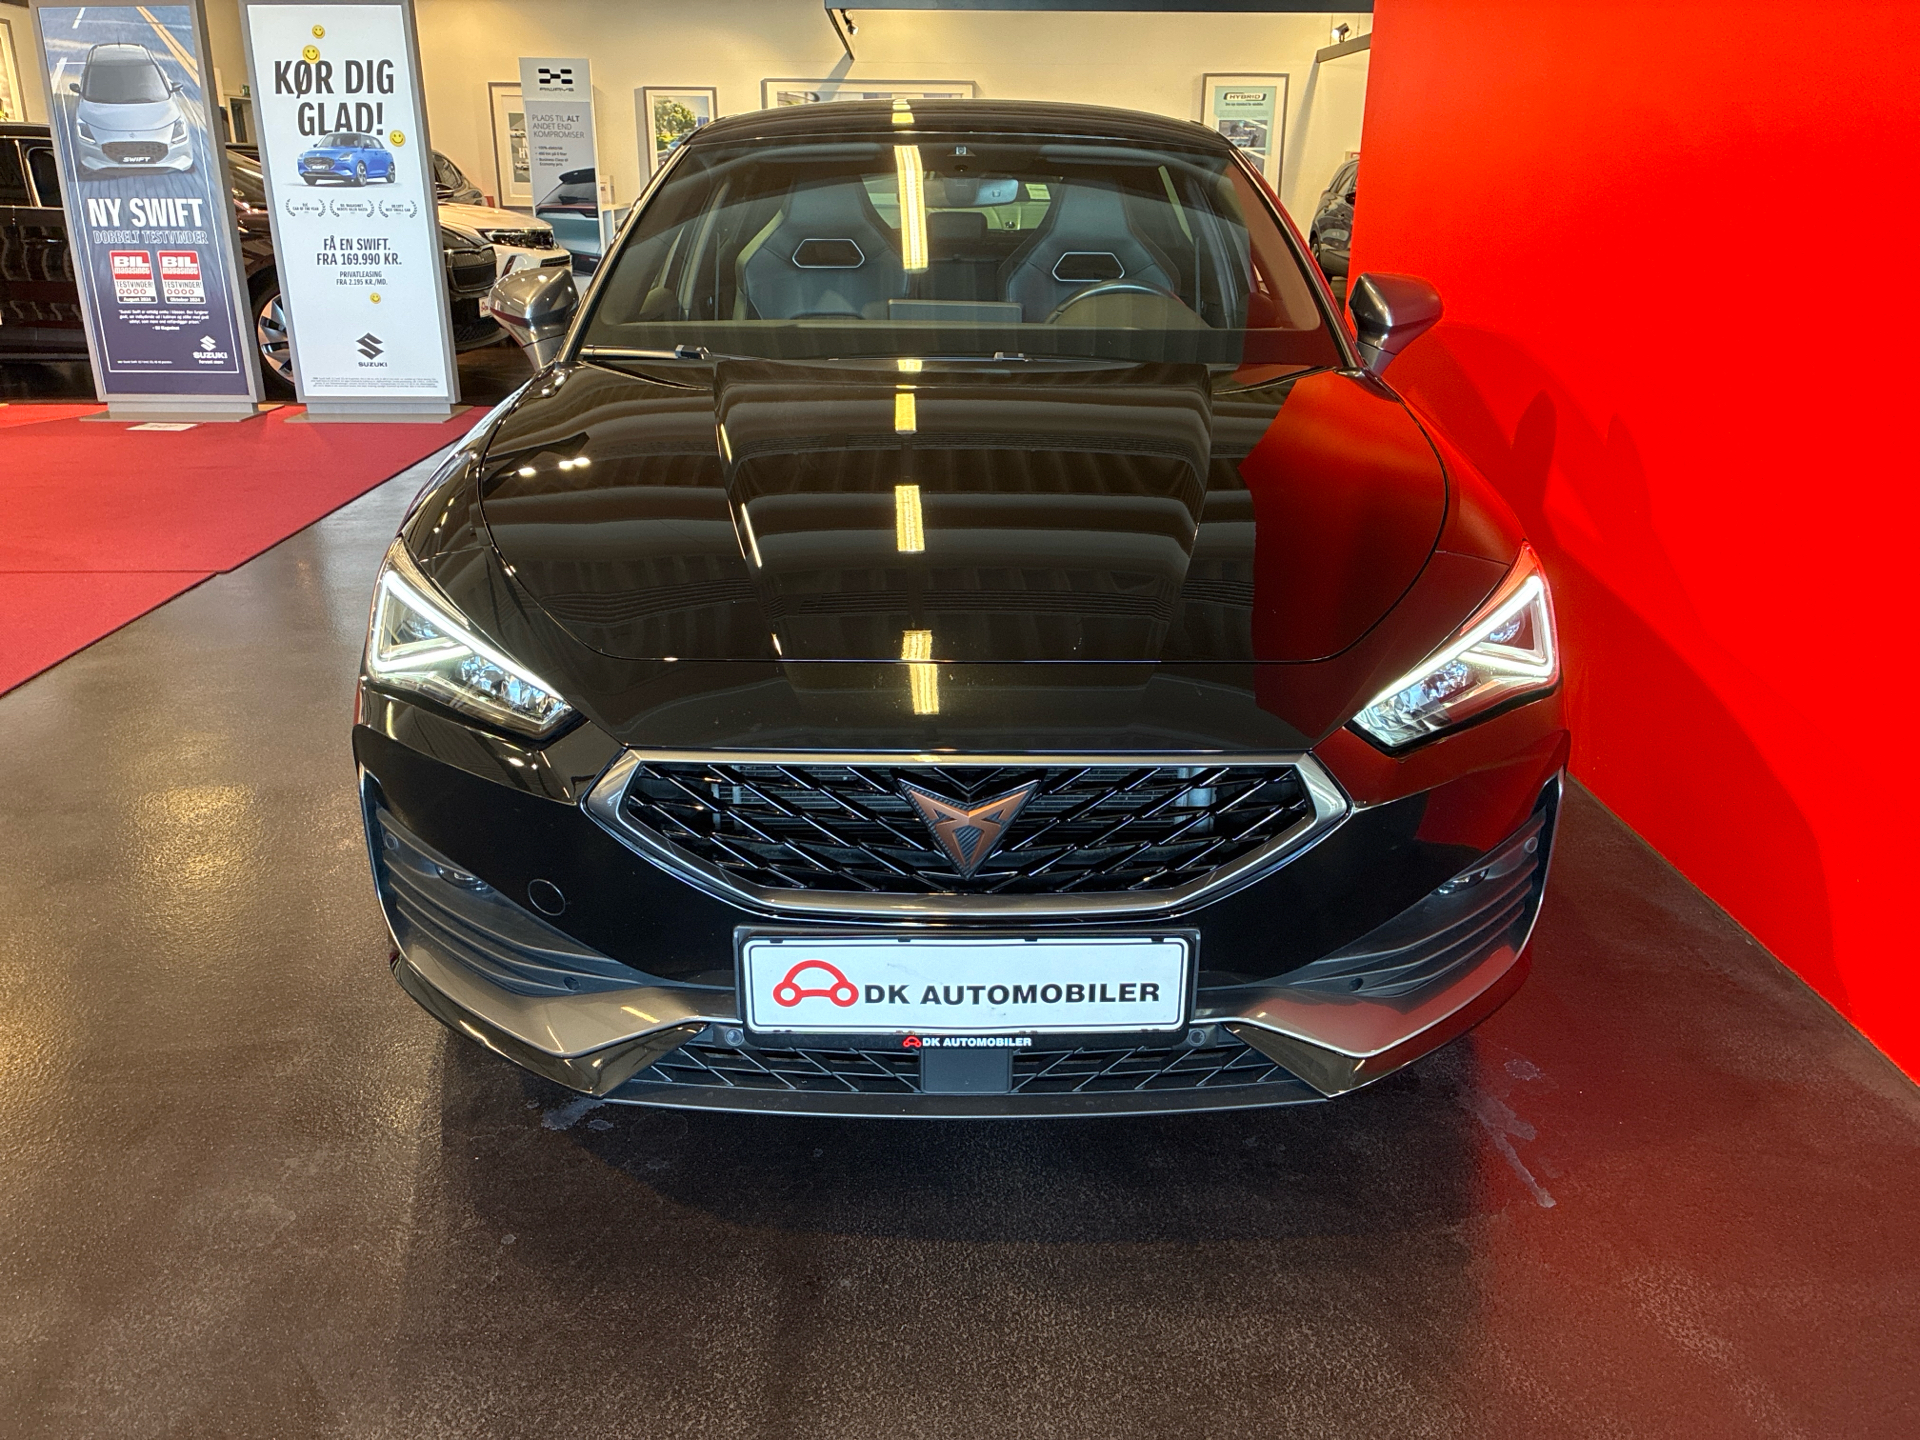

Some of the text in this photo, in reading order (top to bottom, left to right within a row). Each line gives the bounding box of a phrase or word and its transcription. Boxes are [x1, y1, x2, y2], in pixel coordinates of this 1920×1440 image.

[274, 59, 394, 98] KØR DIG
[297, 102, 384, 136] GLAD!
[532, 114, 554, 122] PLADS
[88, 198, 202, 227] NY SWIFT
[93, 230, 208, 244] DOBBELT TESTVINDER
[324, 235, 390, 250] FÅ EN SWIFT.
[114, 256, 150, 268] BIL
[162, 256, 198, 268] BIL
[317, 253, 402, 265] FRA 169.990 KR.
[864, 983, 1160, 1005] DK AUTOMOBILER
[922, 1036, 1032, 1047] DK AUTOMOBILER
